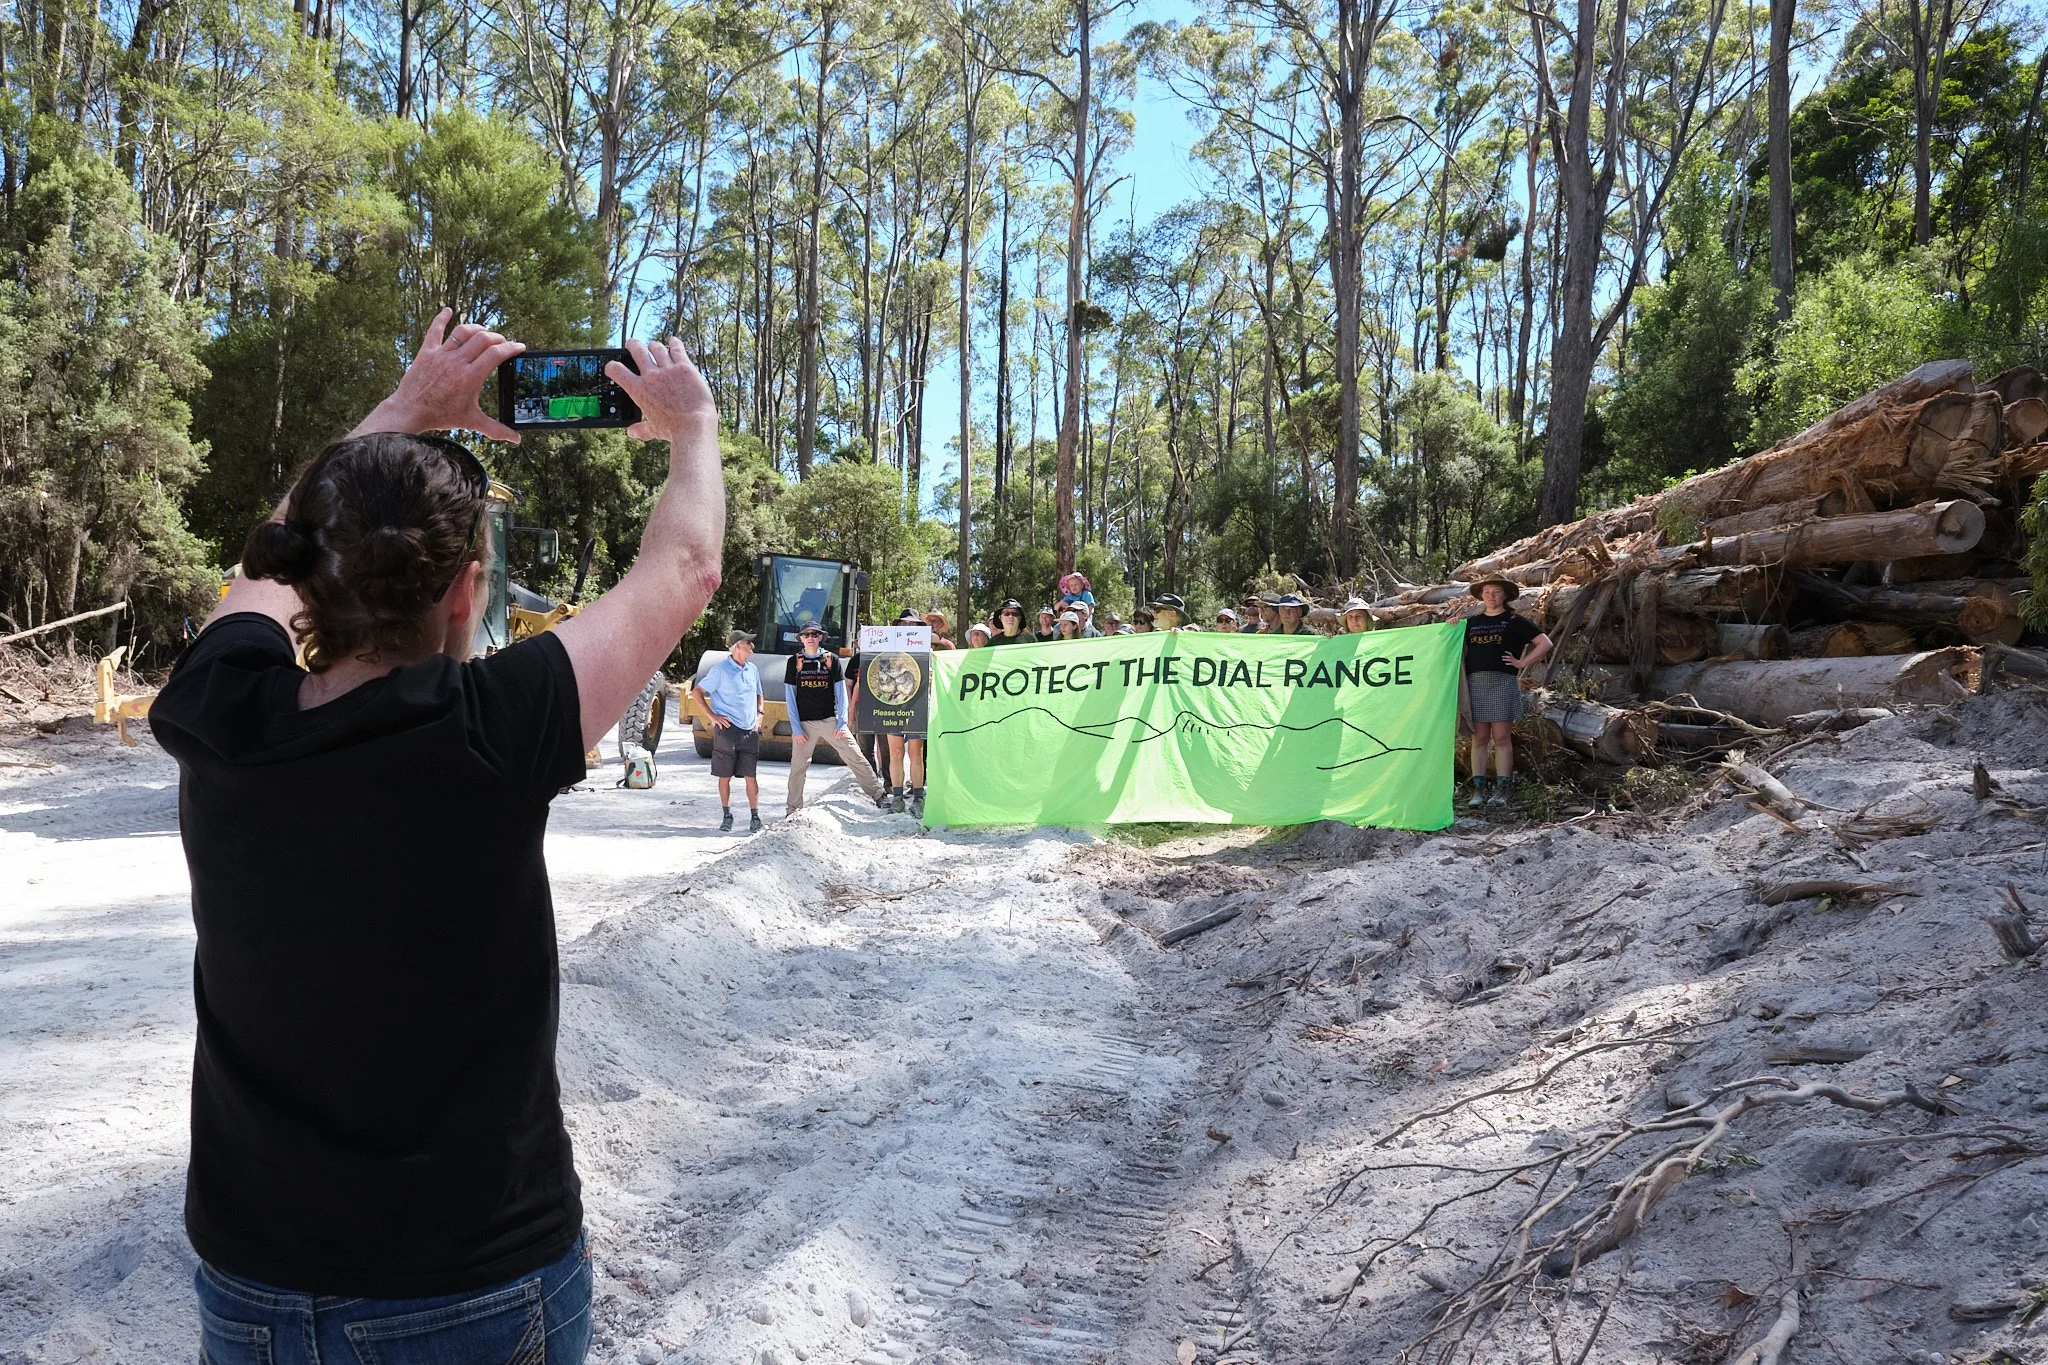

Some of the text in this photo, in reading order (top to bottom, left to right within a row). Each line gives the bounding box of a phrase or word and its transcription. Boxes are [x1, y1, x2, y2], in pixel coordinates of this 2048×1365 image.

[865, 628, 883, 636] This
[959, 655, 1414, 701] PROTECT THE DIAL RANGE
